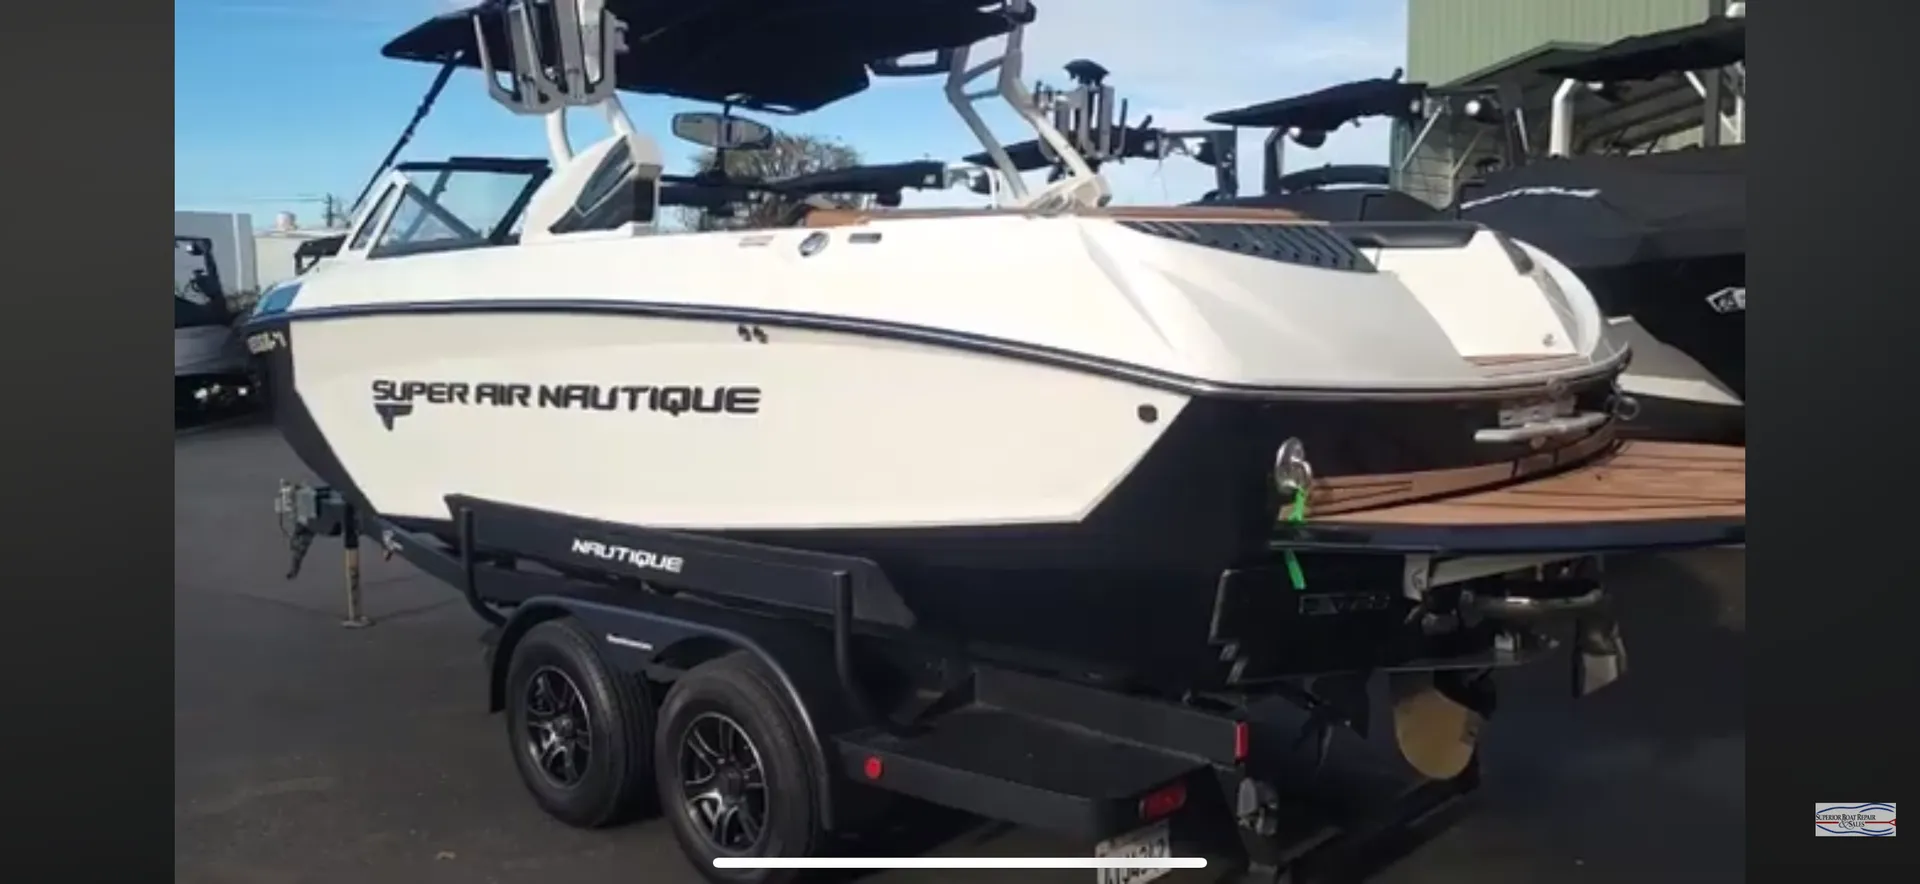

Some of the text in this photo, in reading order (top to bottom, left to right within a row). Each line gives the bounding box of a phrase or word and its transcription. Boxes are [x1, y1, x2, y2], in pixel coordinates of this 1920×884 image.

[372, 379, 761, 417] SUPER AIR NAUTIQUE
[571, 538, 684, 573] NAUTIQUE
